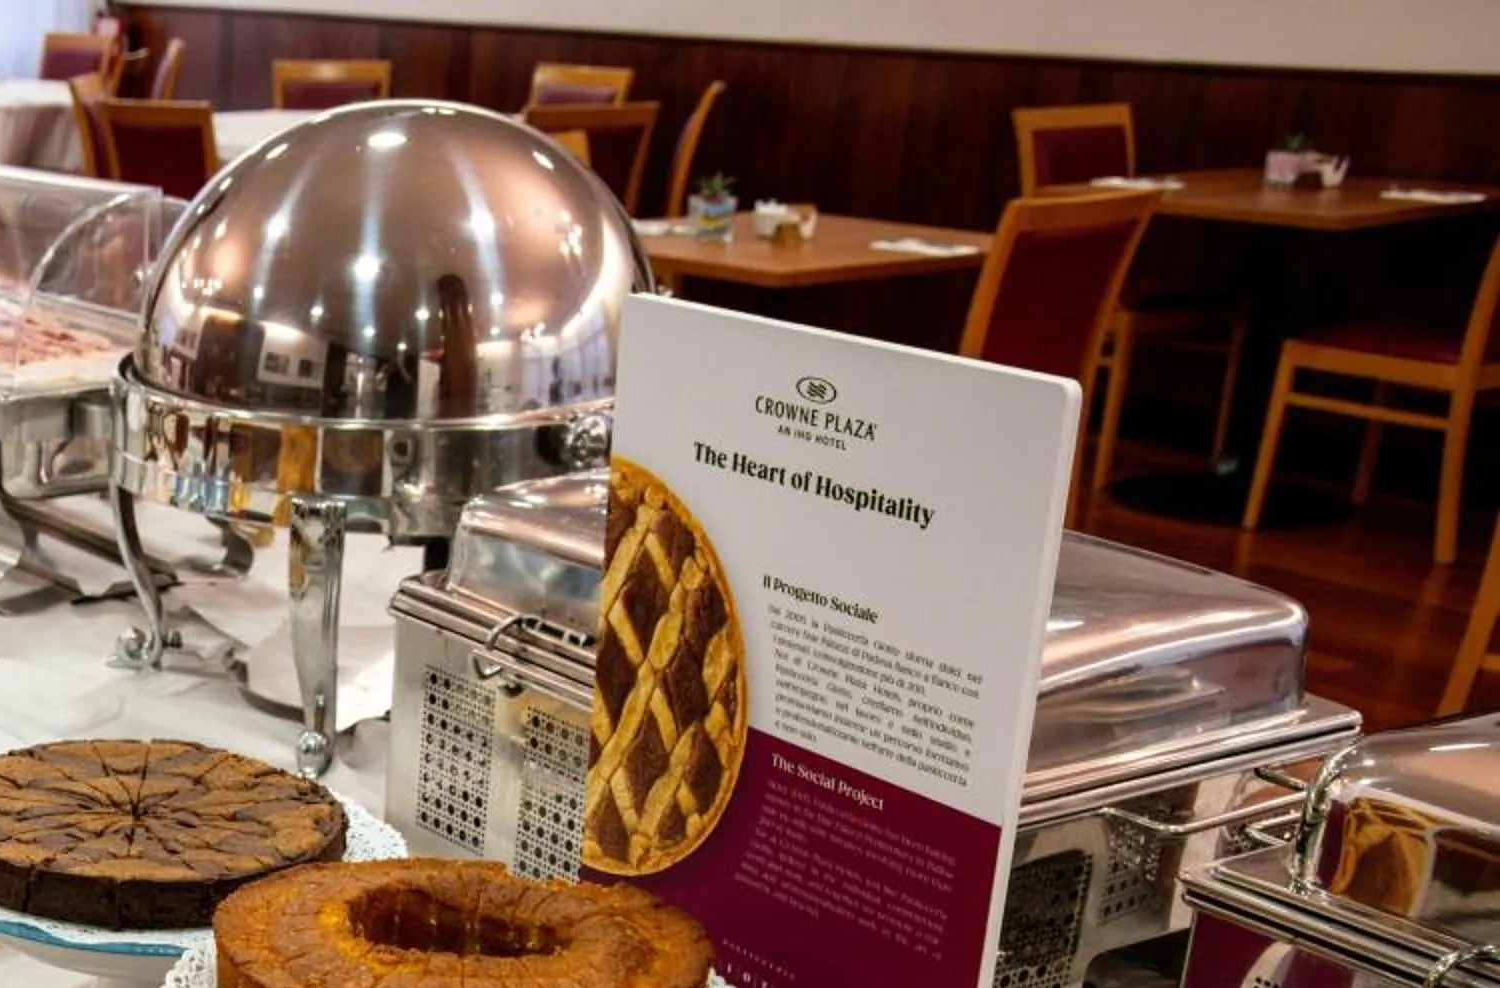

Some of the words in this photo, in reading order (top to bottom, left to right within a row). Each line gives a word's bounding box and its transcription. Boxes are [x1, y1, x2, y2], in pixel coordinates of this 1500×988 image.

[755, 396, 820, 427] CROWNE
[825, 412, 876, 442] PLAZA
[777, 425, 791, 437] AN
[794, 428, 812, 443] IHG
[814, 433, 847, 451] HOTEL
[694, 441, 728, 469] The
[732, 452, 786, 487] Heart
[791, 470, 813, 493] of
[816, 475, 936, 530] Hospitality
[762, 575, 772, 589] Il
[773, 577, 828, 607] Progetto
[830, 596, 879, 625] Sociale
[772, 752, 796, 774] The
[797, 764, 836, 791] Social
[838, 780, 884, 811] Project
